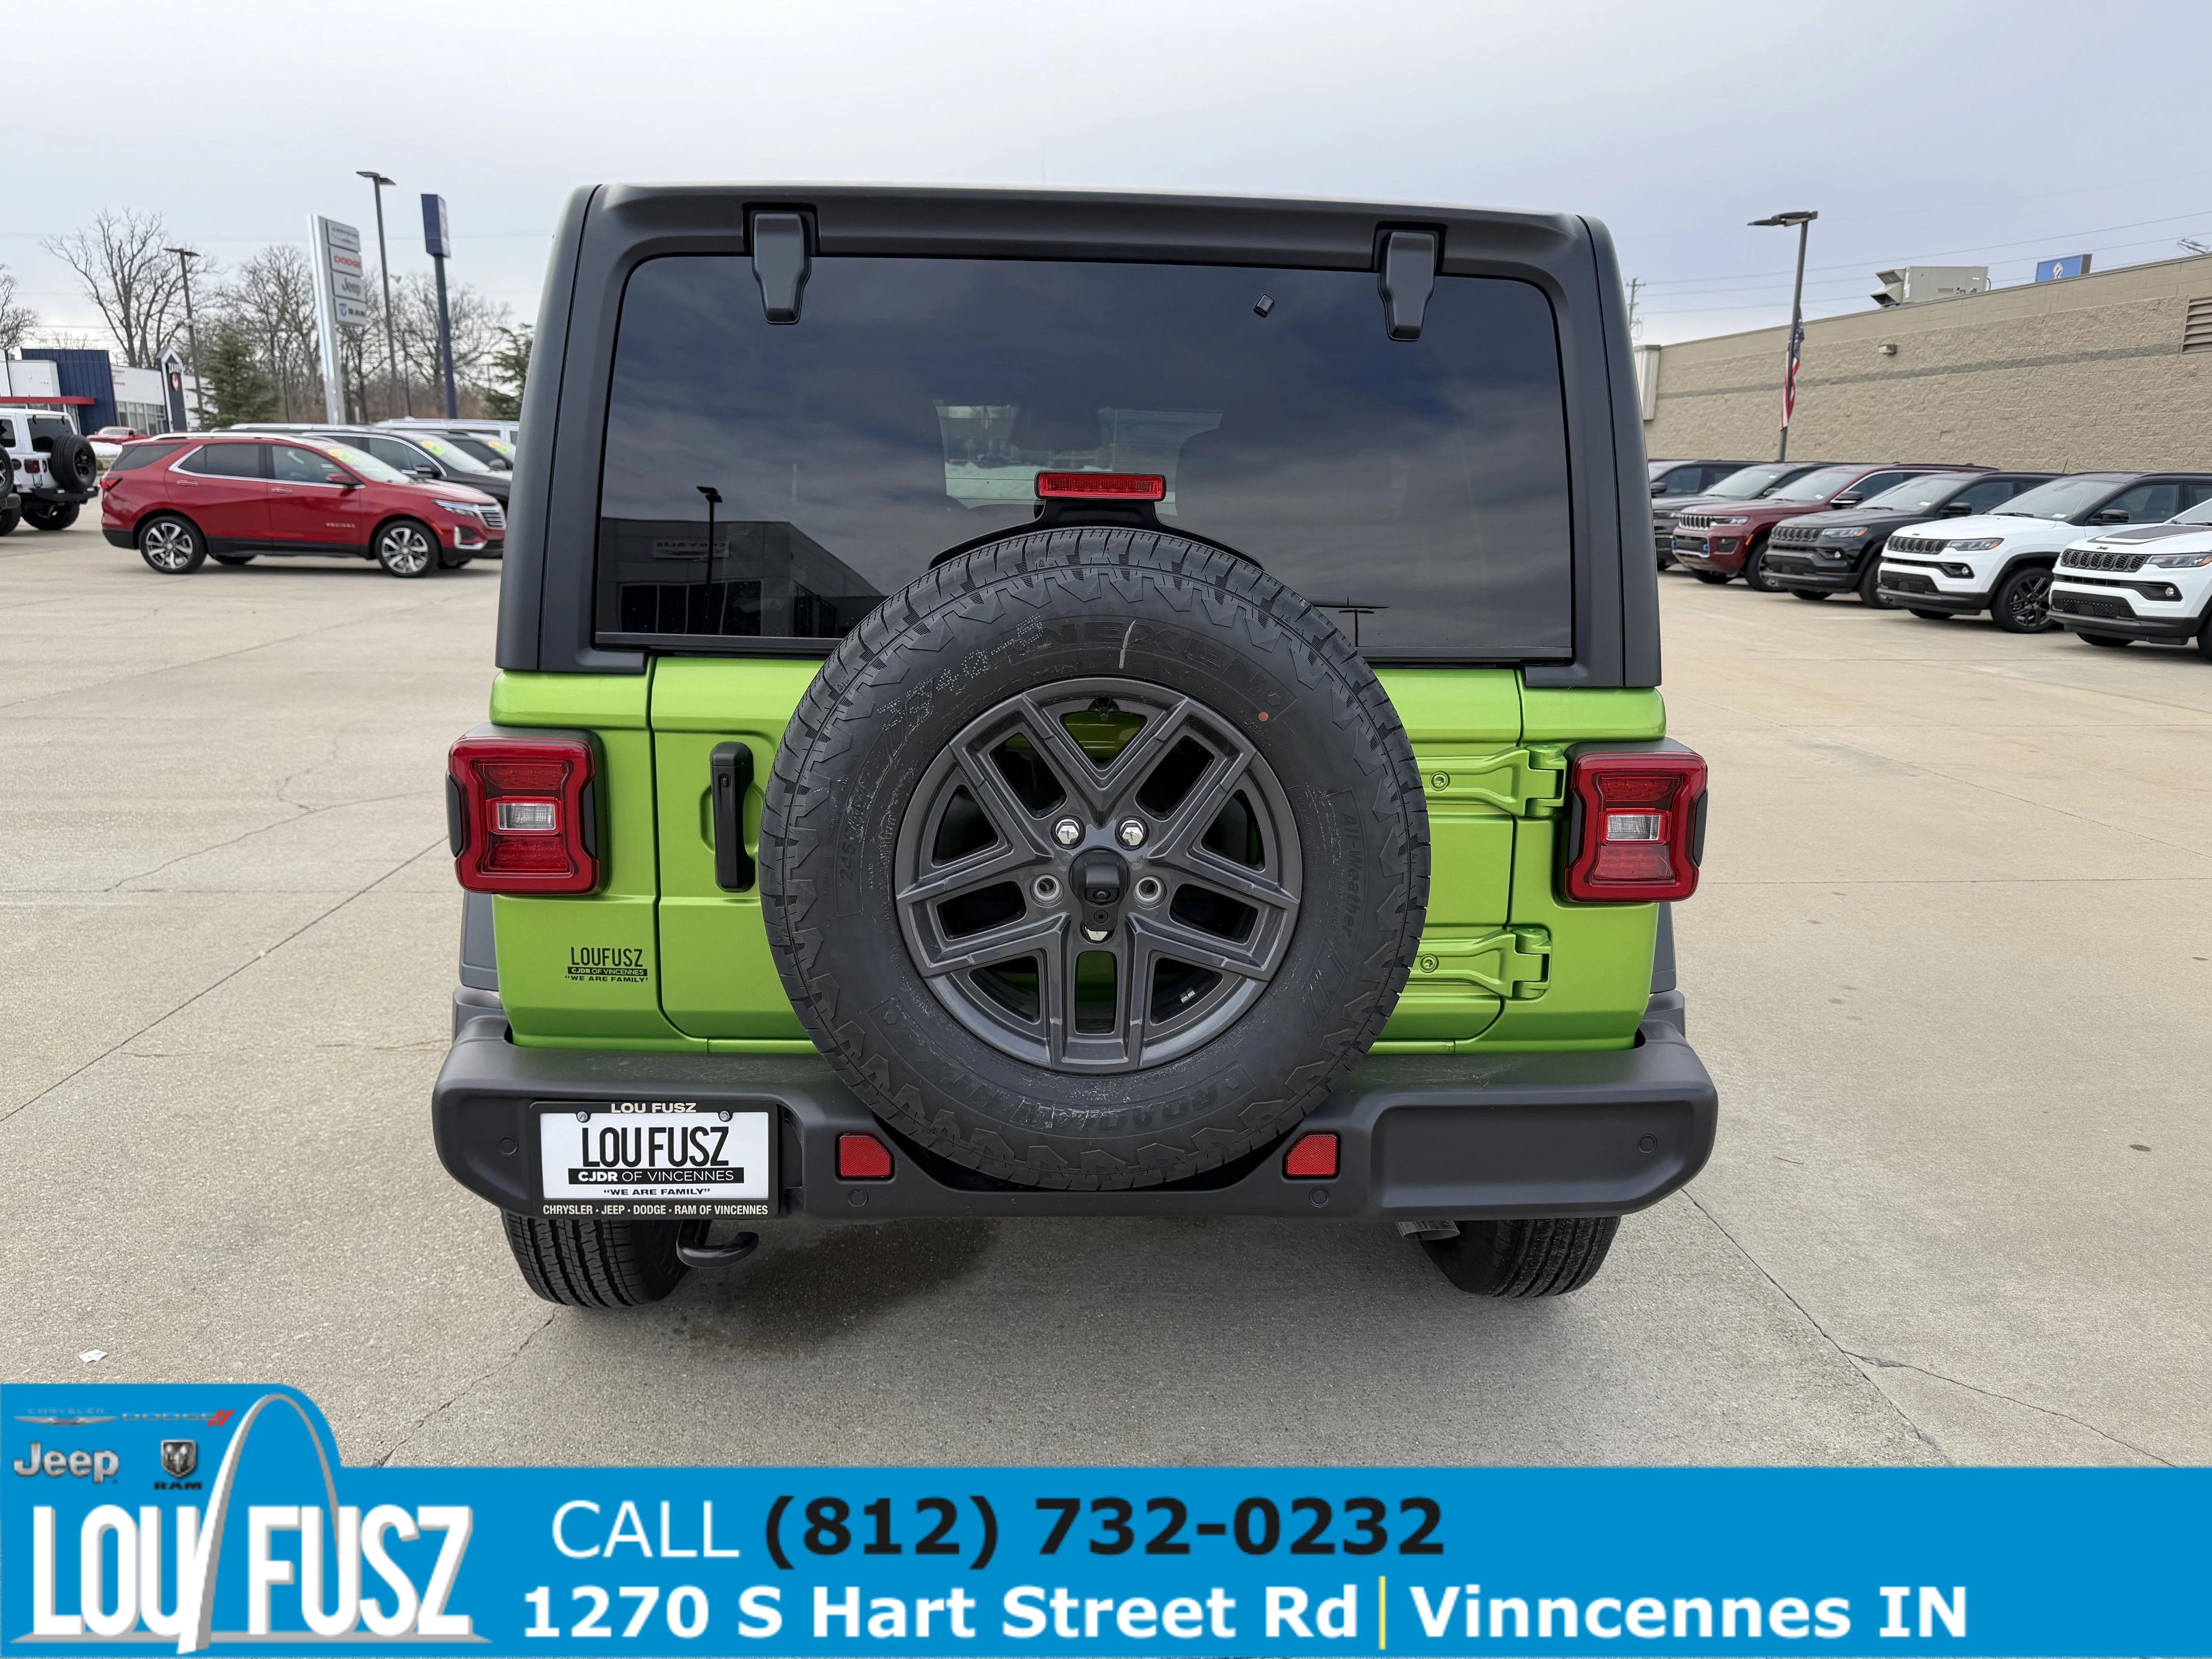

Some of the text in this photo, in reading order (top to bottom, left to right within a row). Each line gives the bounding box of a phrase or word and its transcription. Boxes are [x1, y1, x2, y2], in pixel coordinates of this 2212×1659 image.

[1034, 619, 1268, 699] NEXEN
[611, 1103, 697, 1113] LOU FUSZ
[578, 1170, 734, 1182] CJDR OF VINCENNES
[543, 1205, 768, 1215] CHRYSLER JEEP DODGE RAM OF VINCENNES
